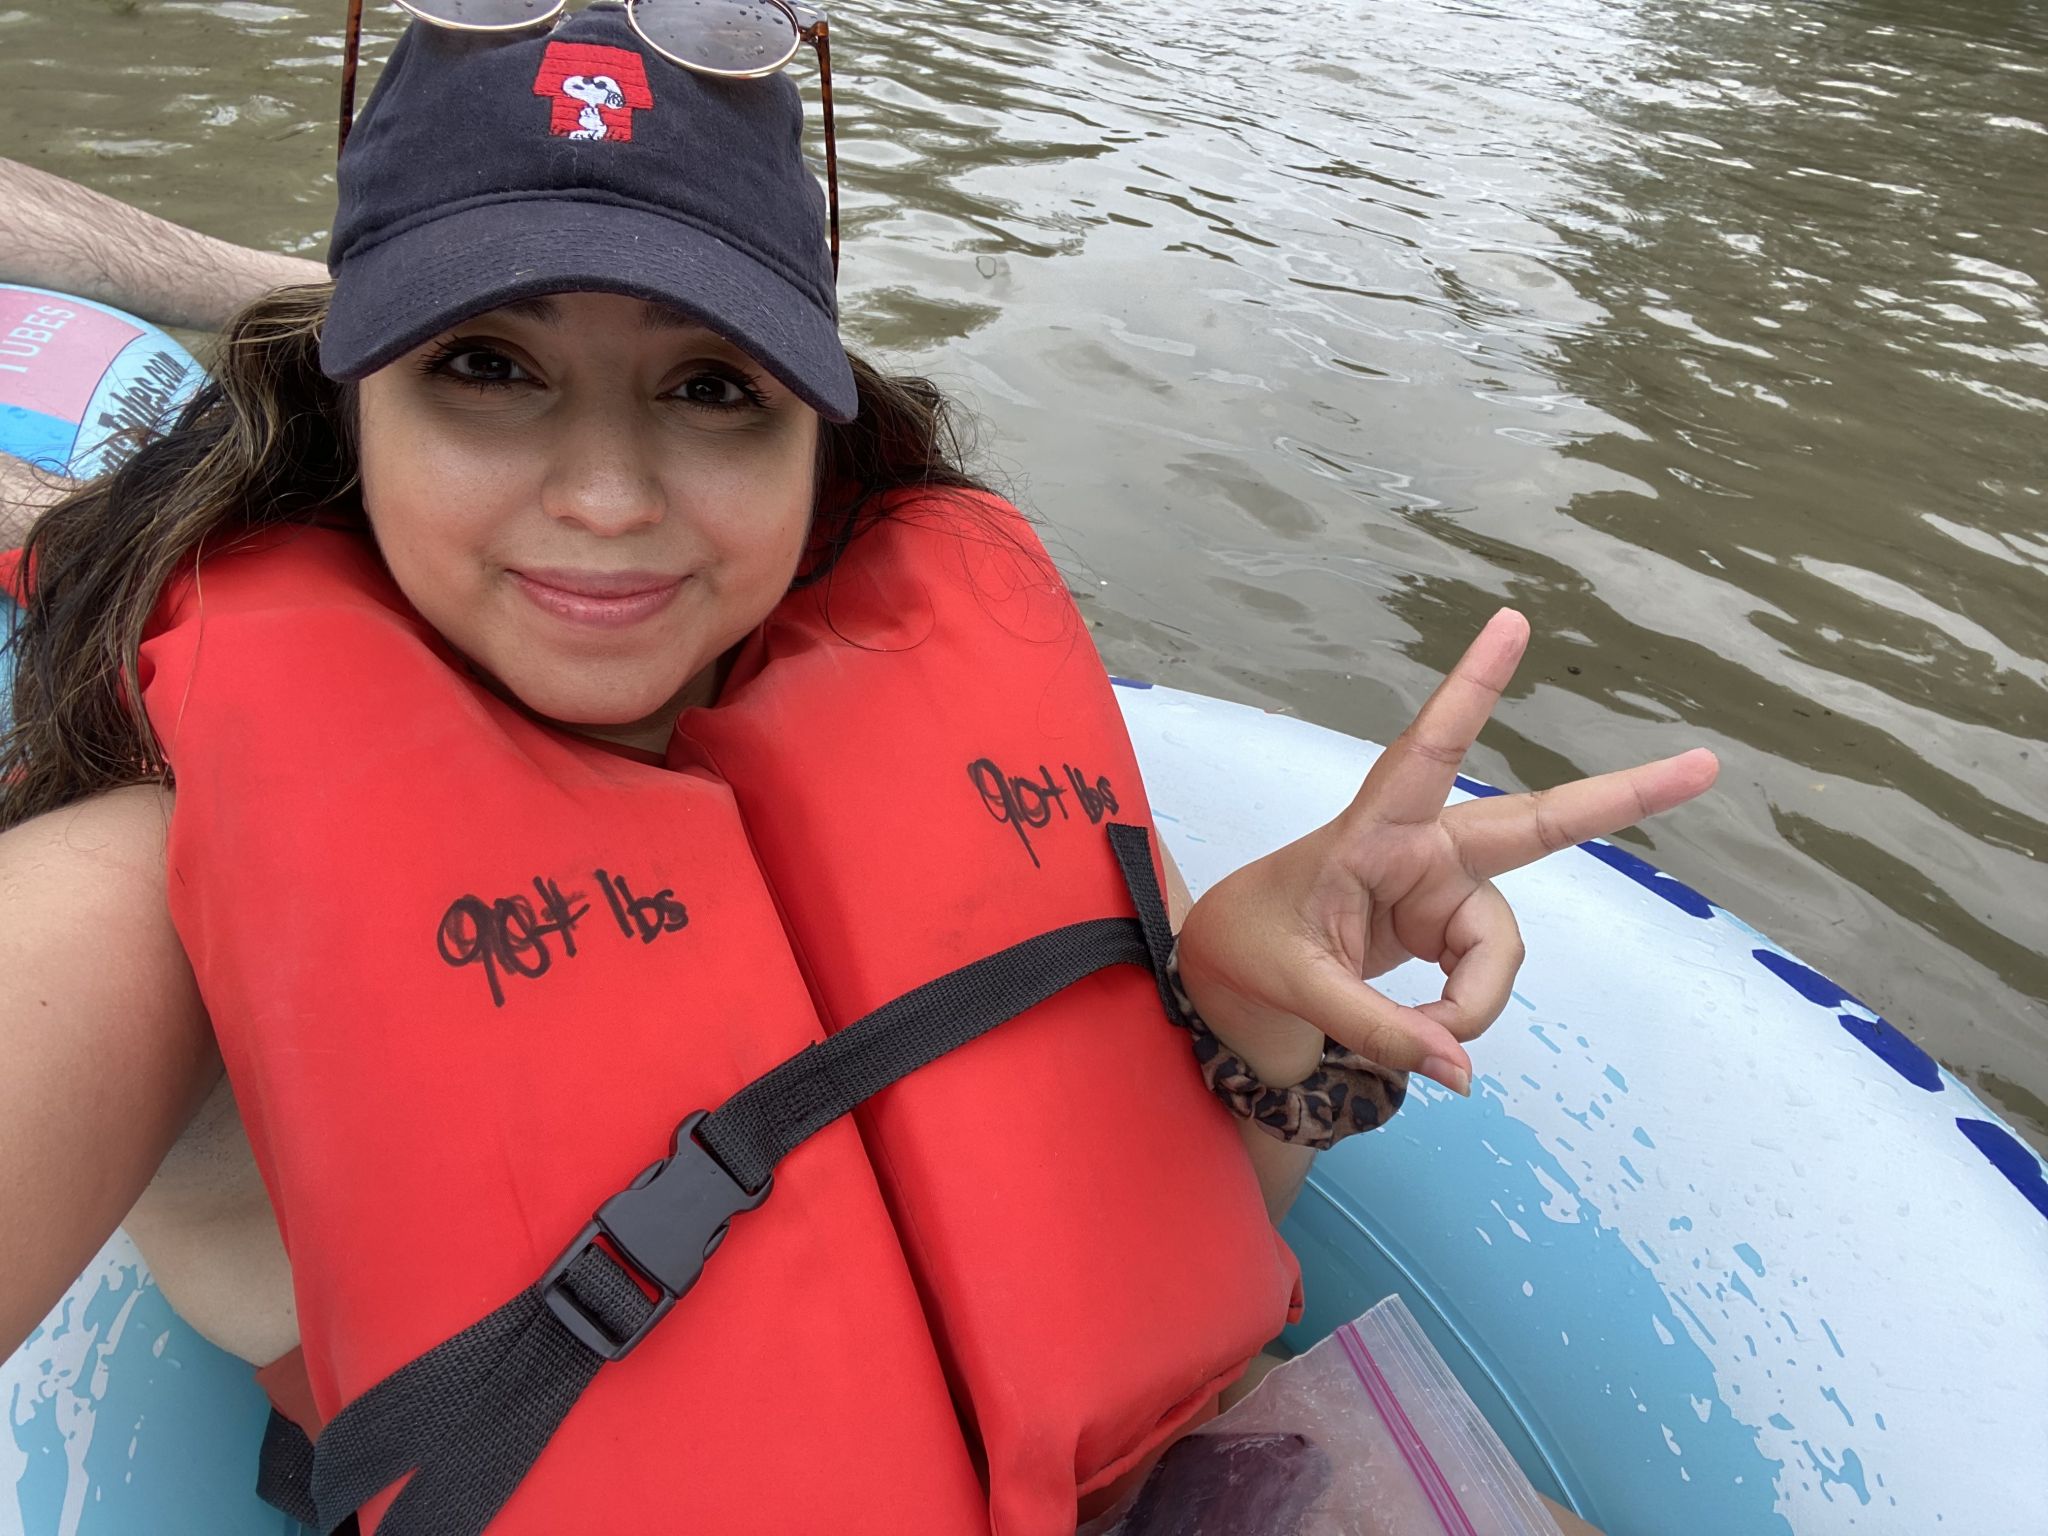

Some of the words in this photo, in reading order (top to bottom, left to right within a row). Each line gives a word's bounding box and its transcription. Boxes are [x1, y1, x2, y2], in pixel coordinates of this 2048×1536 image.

[967, 758, 1067, 869] 90+
[1062, 763, 1119, 825] lbs
[437, 875, 591, 1008] 90+
[593, 868, 690, 945] lbs
